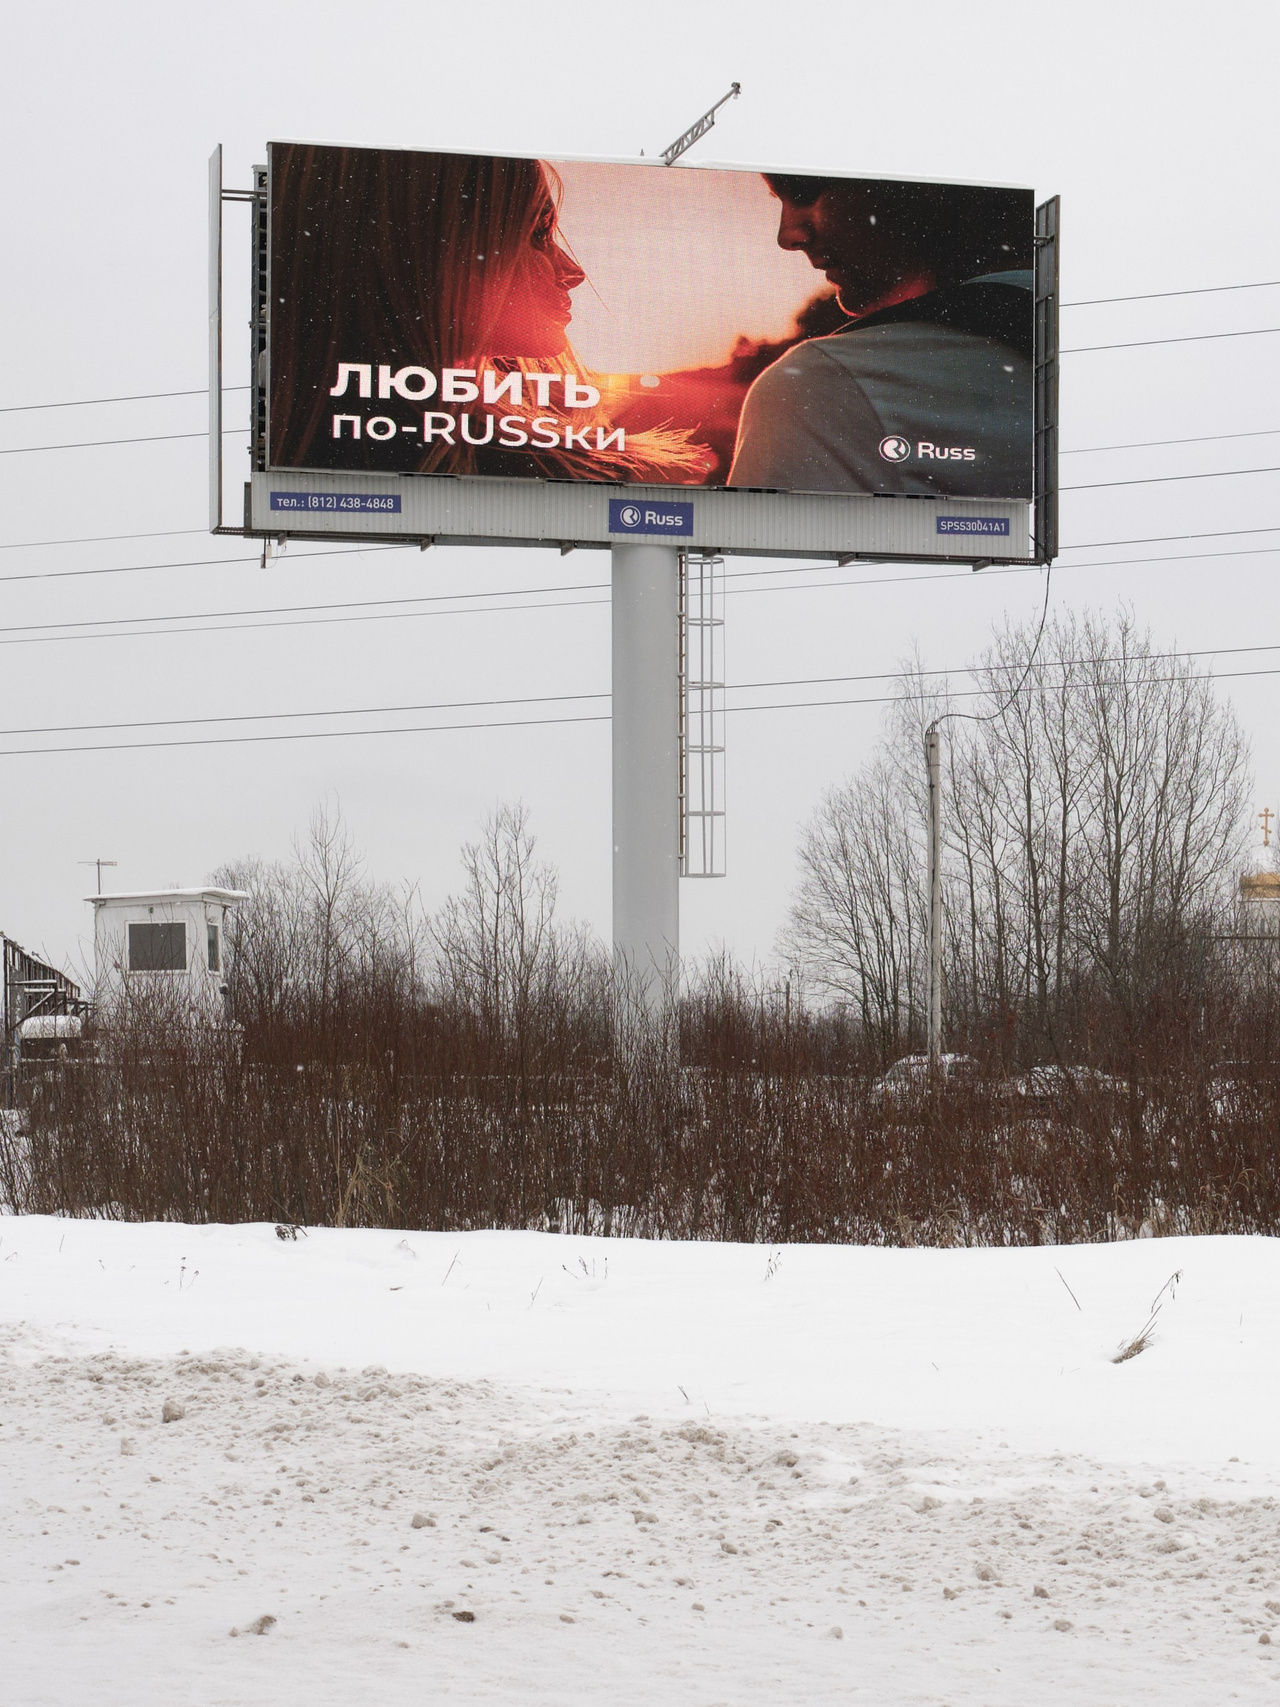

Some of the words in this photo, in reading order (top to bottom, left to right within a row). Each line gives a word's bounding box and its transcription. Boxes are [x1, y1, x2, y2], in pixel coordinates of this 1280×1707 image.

[330, 362, 601, 408] ЛЮБИТЬ
[332, 411, 626, 451] по-RUSSки
[917, 441, 976, 461] Russ
[276, 497, 305, 507] тел.:
[308, 495, 337, 509] (812)
[339, 497, 394, 509] 438-4848
[645, 510, 683, 526] Russ
[940, 520, 1005, 532] SPSS30041A1
